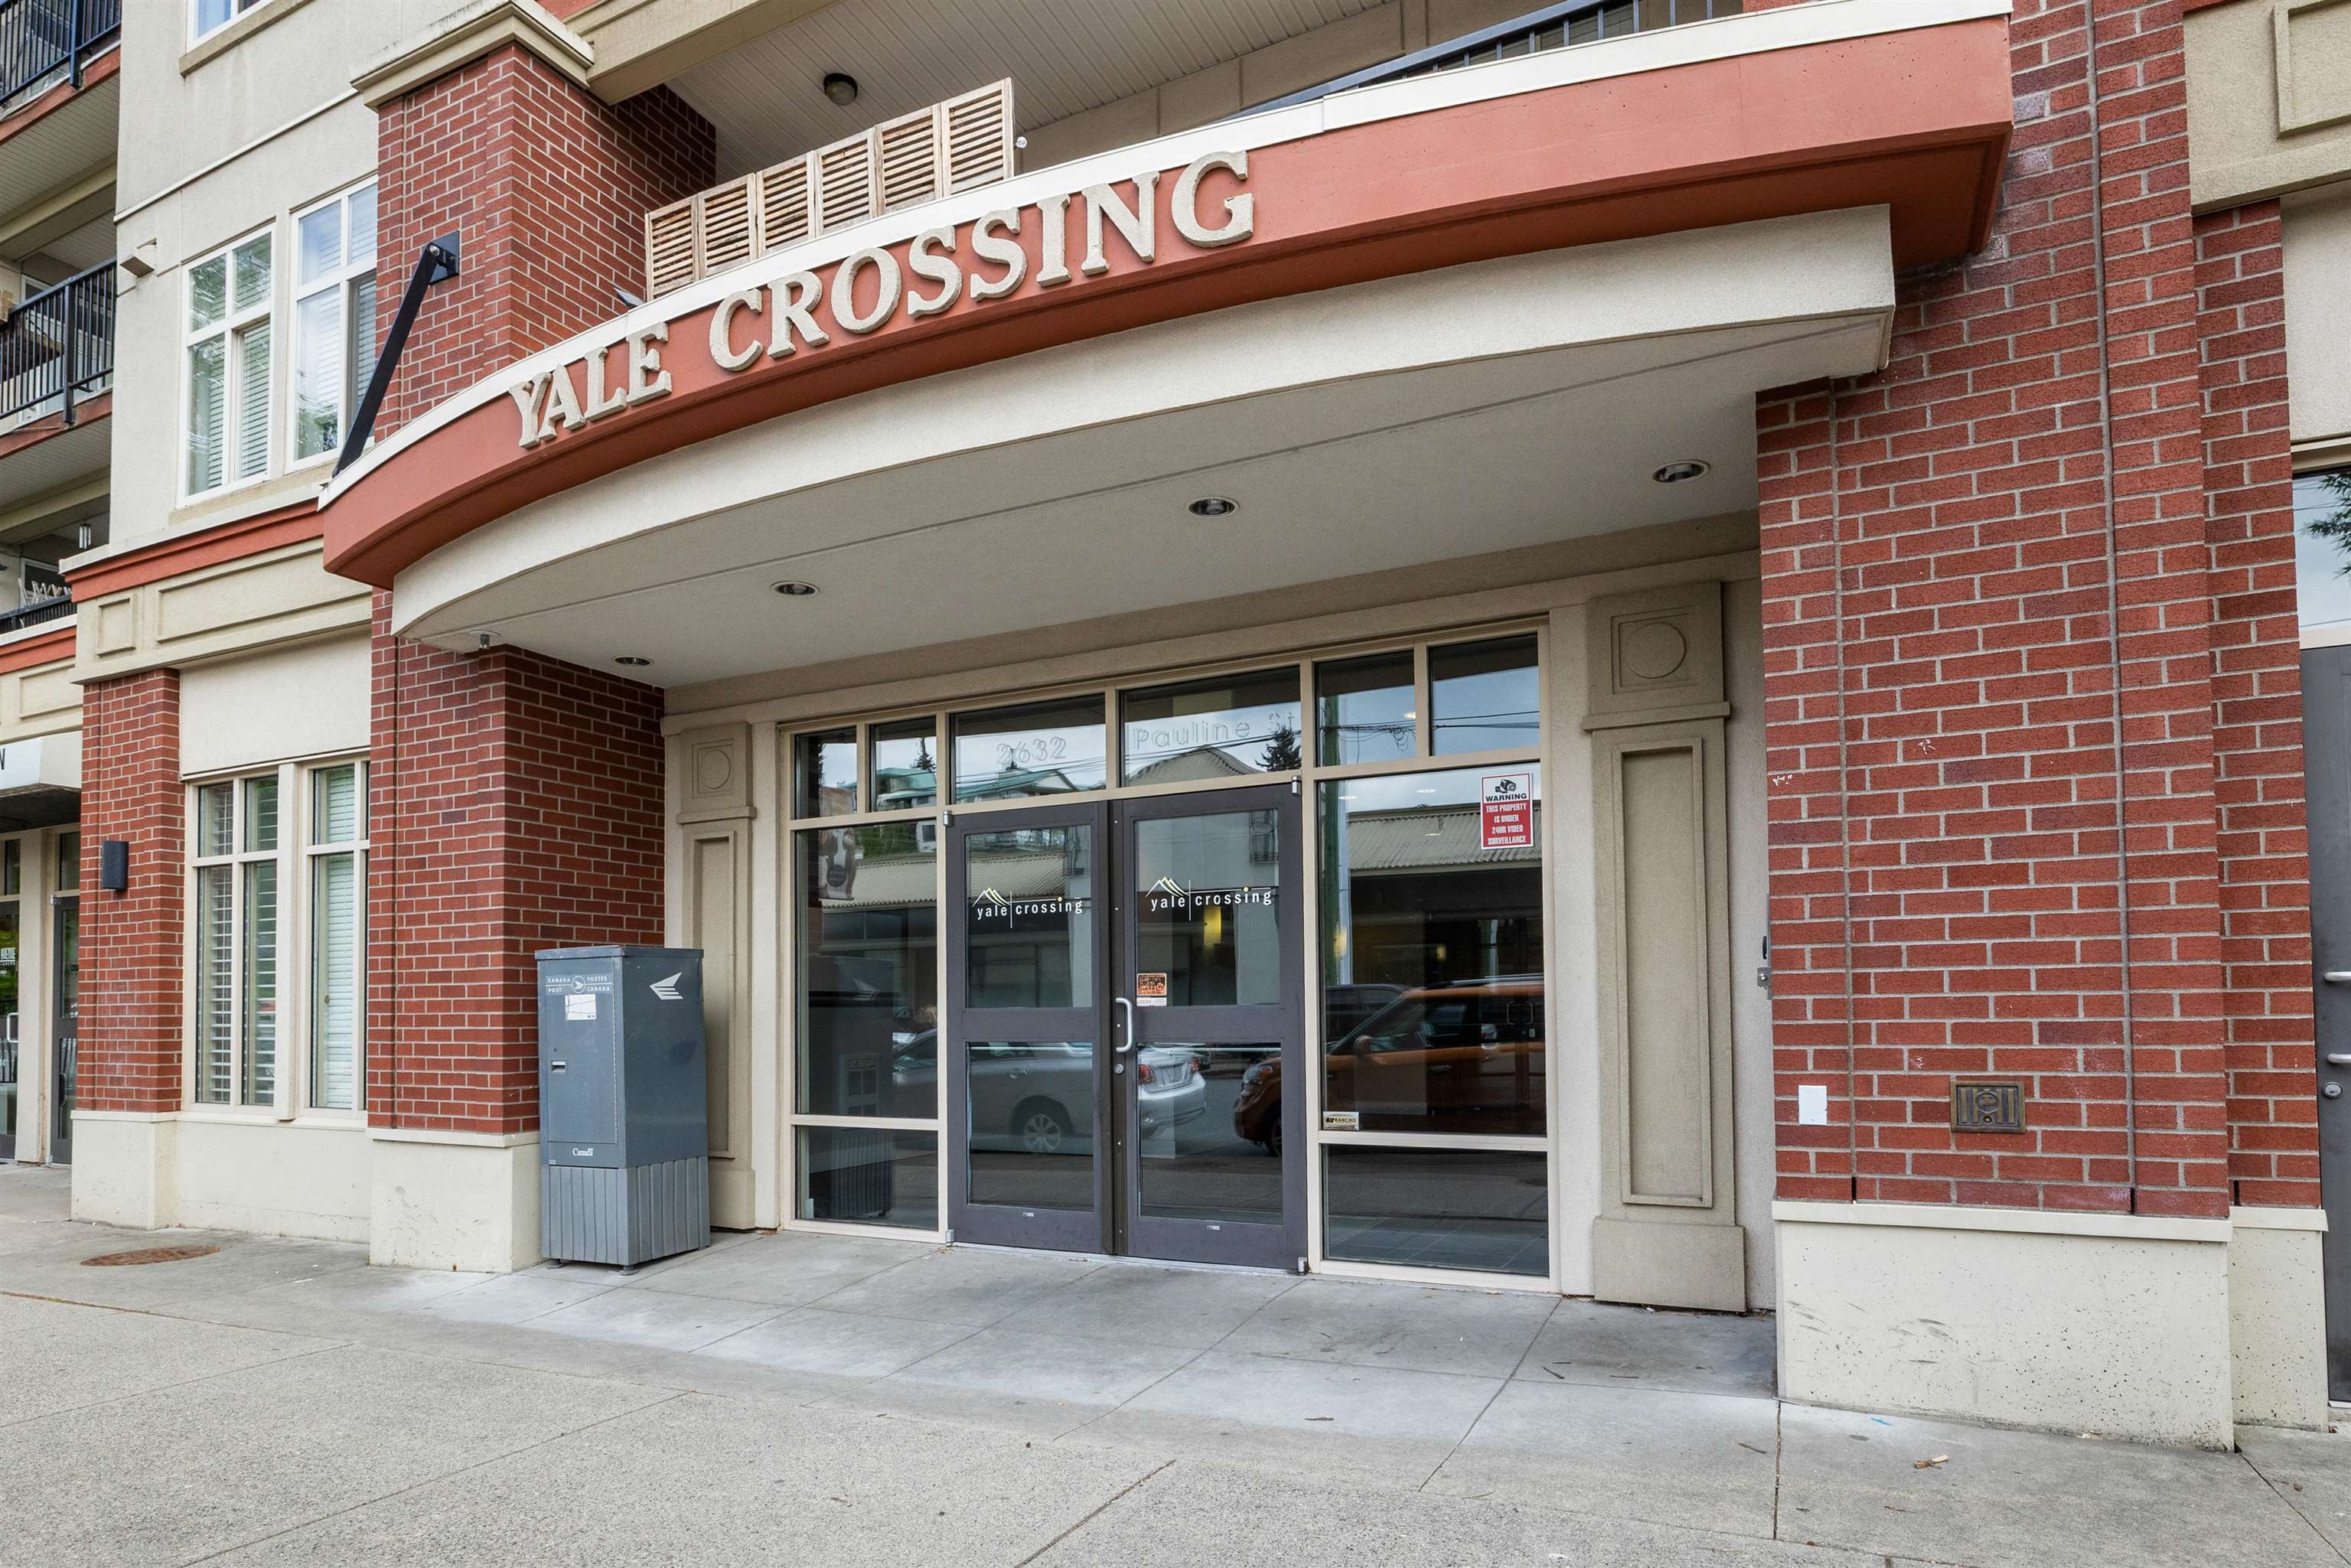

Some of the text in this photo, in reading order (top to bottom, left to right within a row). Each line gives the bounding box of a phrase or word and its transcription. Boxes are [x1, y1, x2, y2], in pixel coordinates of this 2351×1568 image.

[507, 150, 1255, 450] YALE CROSSING
[996, 710, 1296, 765] 2632 Pauline St
[1485, 793, 1527, 802] WARNING
[1499, 803, 1527, 812] PROPERTY
[1494, 814, 1519, 823] IS UNDER
[1492, 825, 1523, 834] 24HR VIDEO
[1487, 836, 1527, 846] SURVEILLANCE
[1150, 887, 1272, 911] yale crossing
[977, 897, 1083, 920] yale crossing
